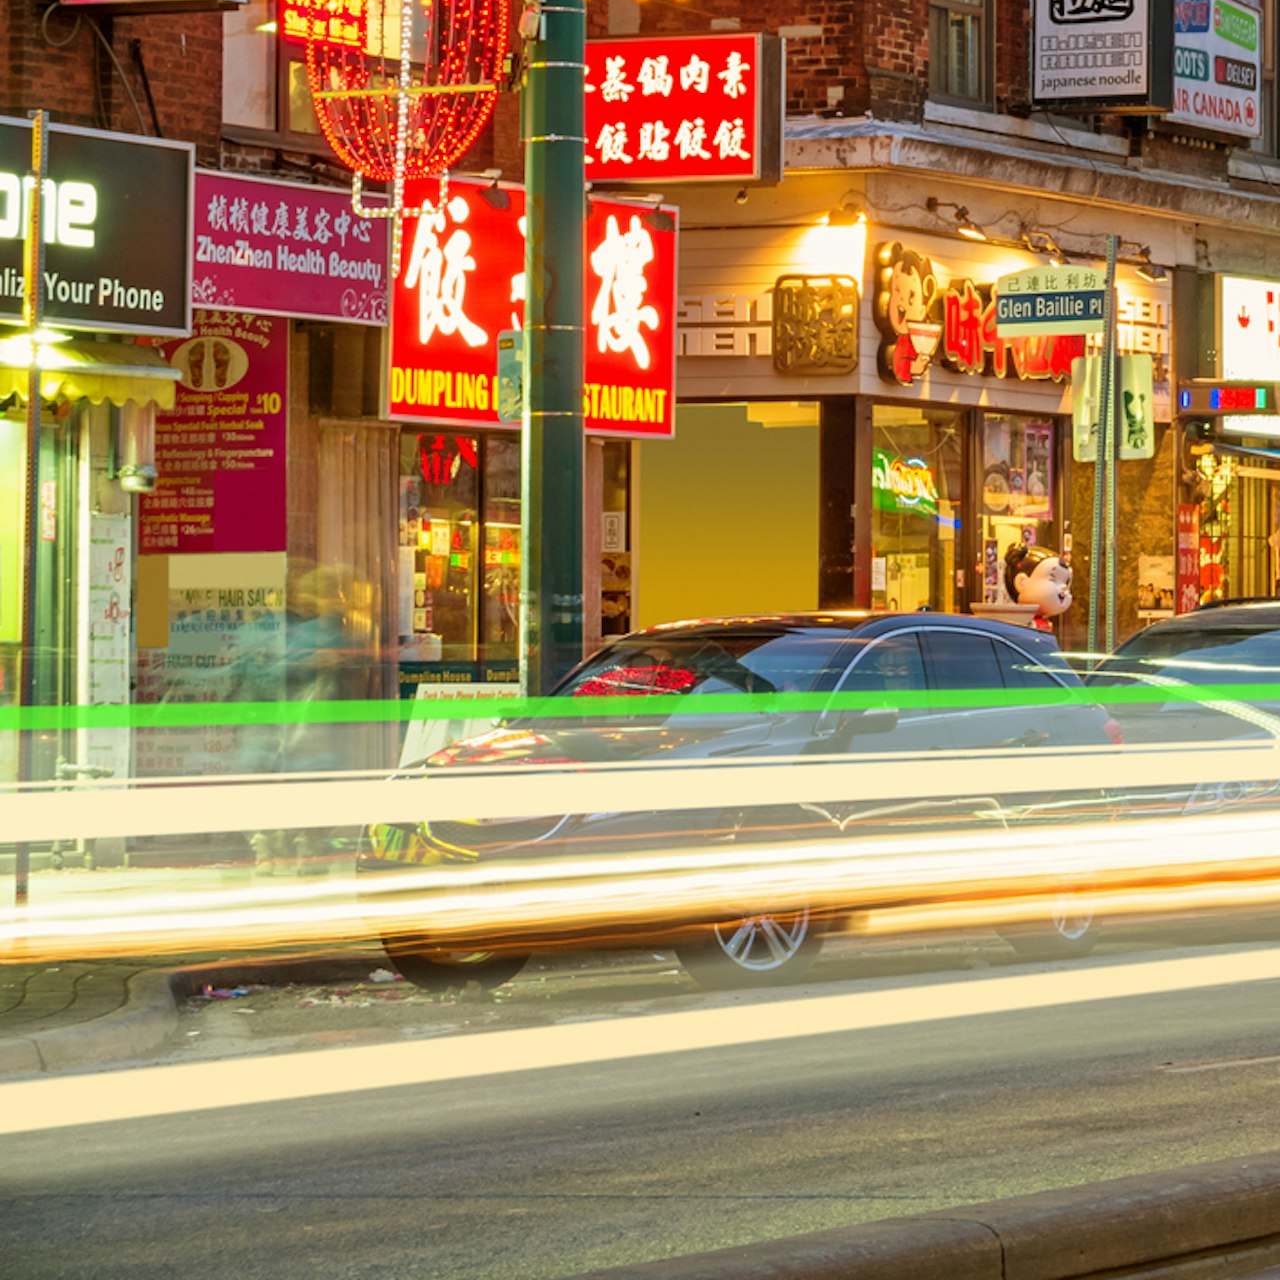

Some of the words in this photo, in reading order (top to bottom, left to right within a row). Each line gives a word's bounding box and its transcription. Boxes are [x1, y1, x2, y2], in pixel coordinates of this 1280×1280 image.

[1041, 73, 1096, 92] japanese
[1099, 70, 1142, 87] noodle
[1192, 91, 1243, 124] CANADA
[196, 235, 273, 269] ZhenZhen
[277, 244, 326, 275] Health
[328, 251, 382, 288] Beauty
[43, 272, 95, 306] Your
[98, 277, 164, 312] Phone
[998, 298, 1032, 319] Glen
[1036, 295, 1084, 318] Baillie
[1089, 297, 1102, 315] Pl
[200, 326, 232, 337] Health
[235, 327, 271, 348] Beauty
[391, 367, 489, 411] DUMPLING
[207, 405, 247, 417] Special
[257, 391, 281, 414] $10
[218, 589, 245, 607] HAIR
